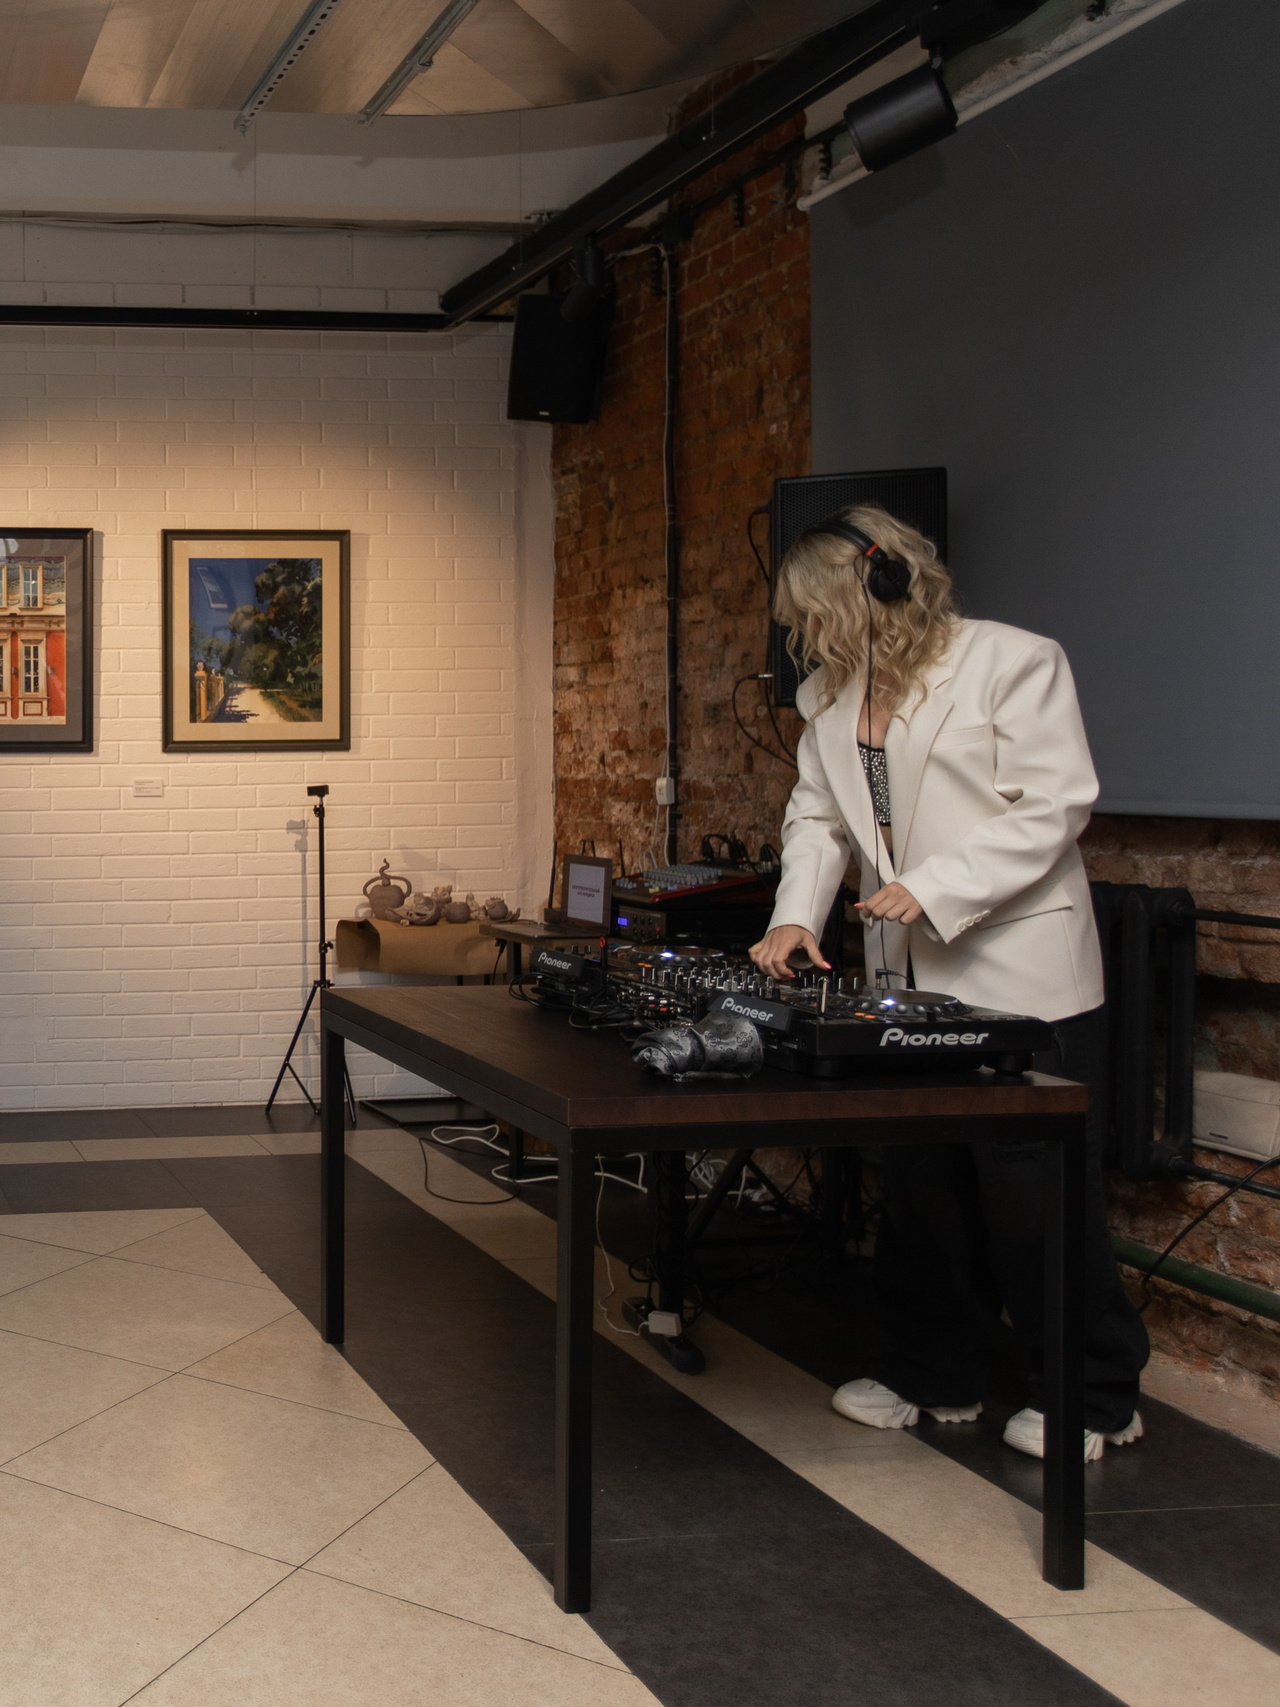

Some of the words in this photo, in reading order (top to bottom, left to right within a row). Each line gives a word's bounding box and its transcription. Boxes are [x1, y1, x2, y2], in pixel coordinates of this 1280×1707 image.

[537, 951, 572, 970] Pioneer
[721, 997, 774, 1022] Pioneer
[879, 1027, 989, 1047] Pioneer
